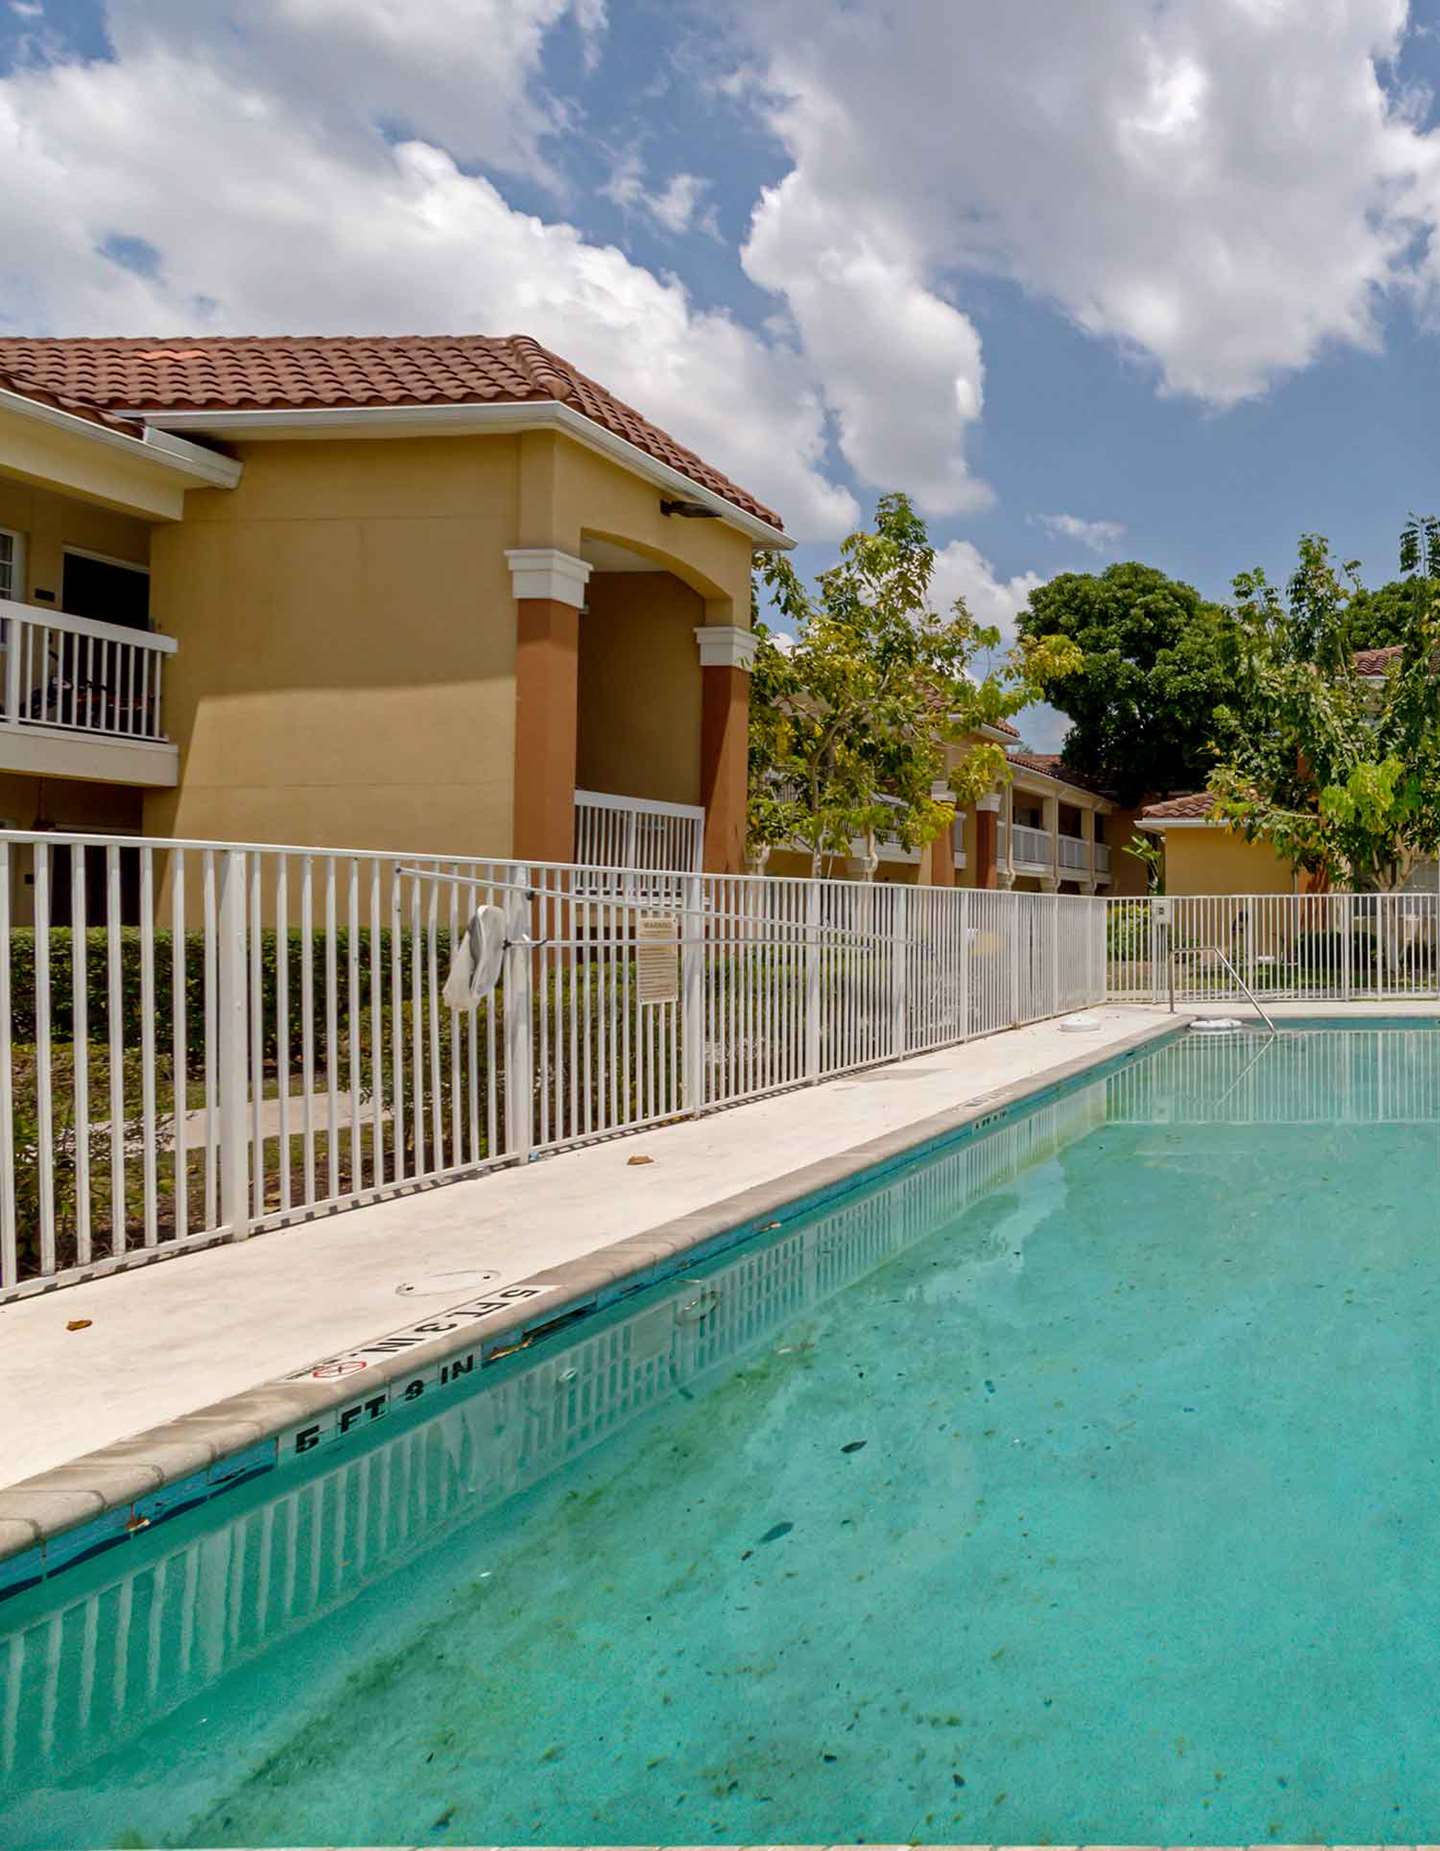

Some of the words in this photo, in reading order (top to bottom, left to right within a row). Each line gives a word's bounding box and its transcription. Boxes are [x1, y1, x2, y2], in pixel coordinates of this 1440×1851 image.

[500, 1289, 540, 1298] 5
[414, 1322, 457, 1333] 3
[296, 1424, 320, 1455] 5
[340, 1394, 387, 1433] FT
[441, 1354, 474, 1385] IN
